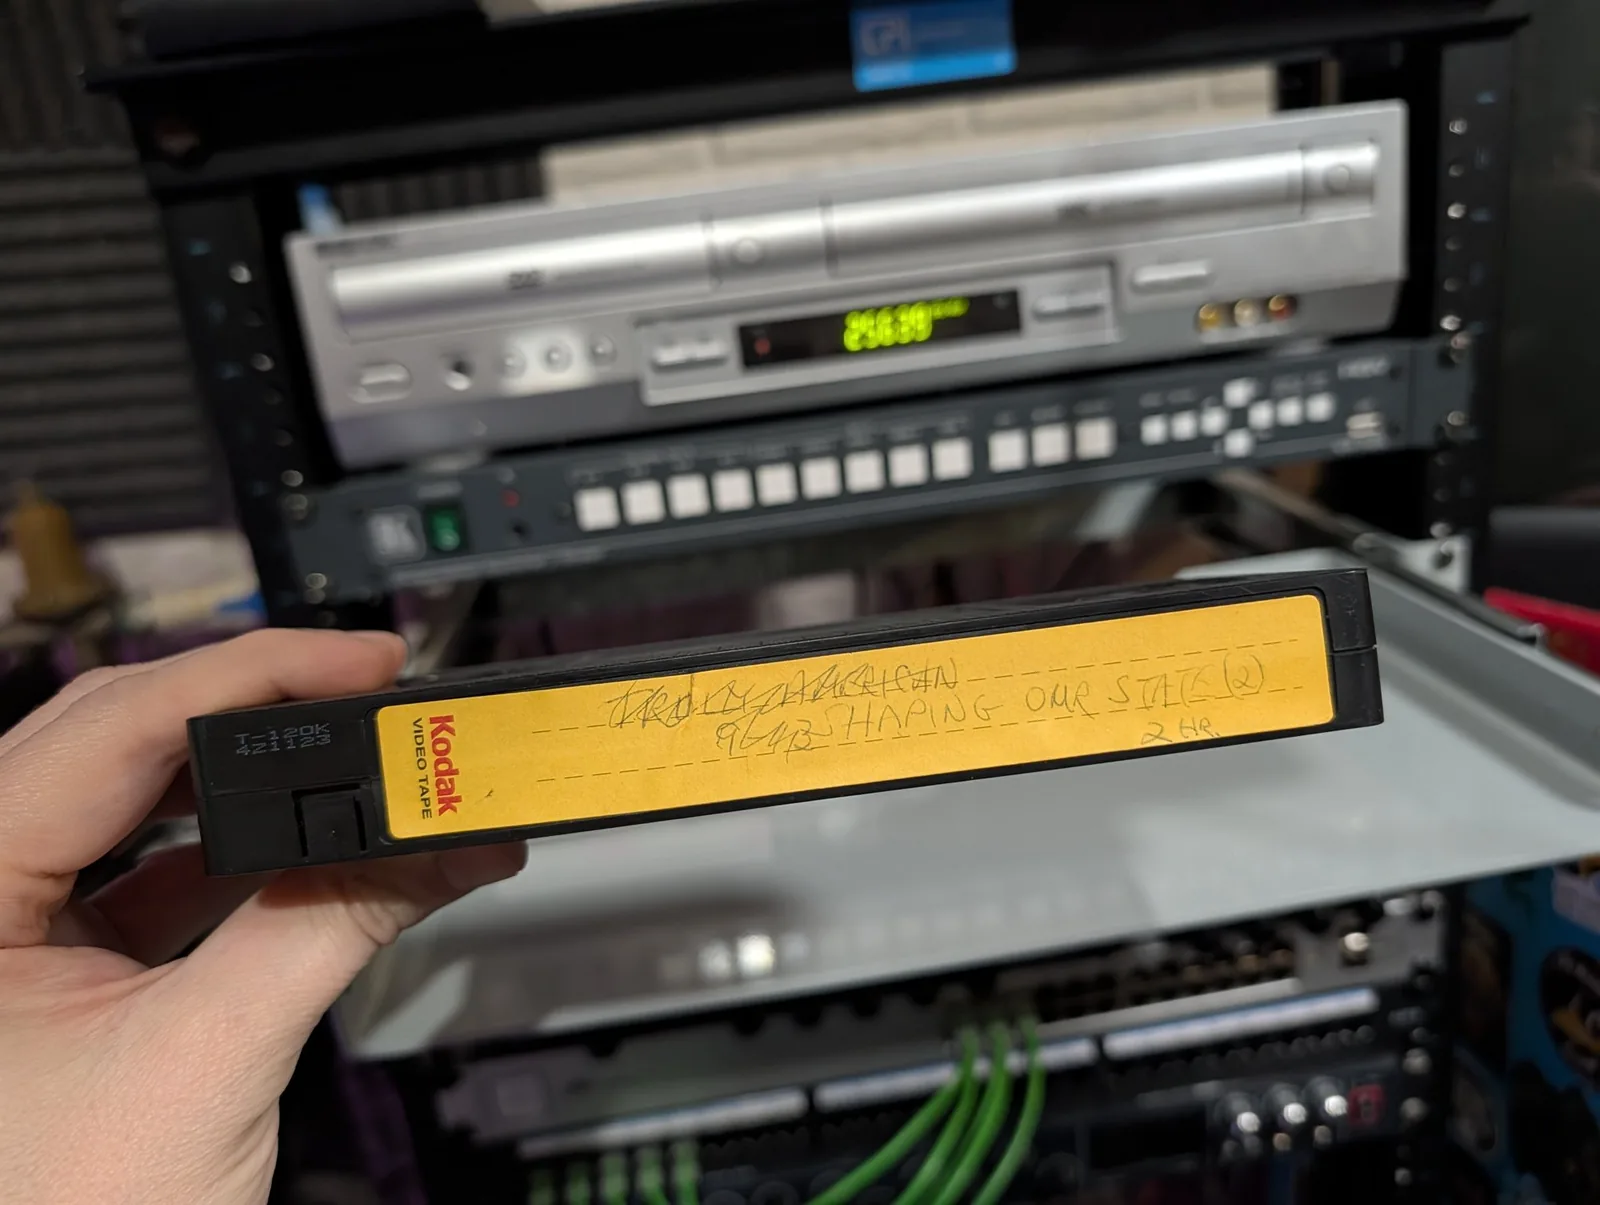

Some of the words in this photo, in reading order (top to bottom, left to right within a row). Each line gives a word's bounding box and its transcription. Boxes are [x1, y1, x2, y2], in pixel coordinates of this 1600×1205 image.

[234, 722, 331, 745] T-120K
[803, 694, 1004, 741] SHAPING
[1025, 682, 1095, 719] OUR
[1141, 721, 1173, 745] 2
[411, 717, 428, 771] VIDEO
[429, 714, 463, 816] Kodak
[418, 774, 433, 820] TAPE
